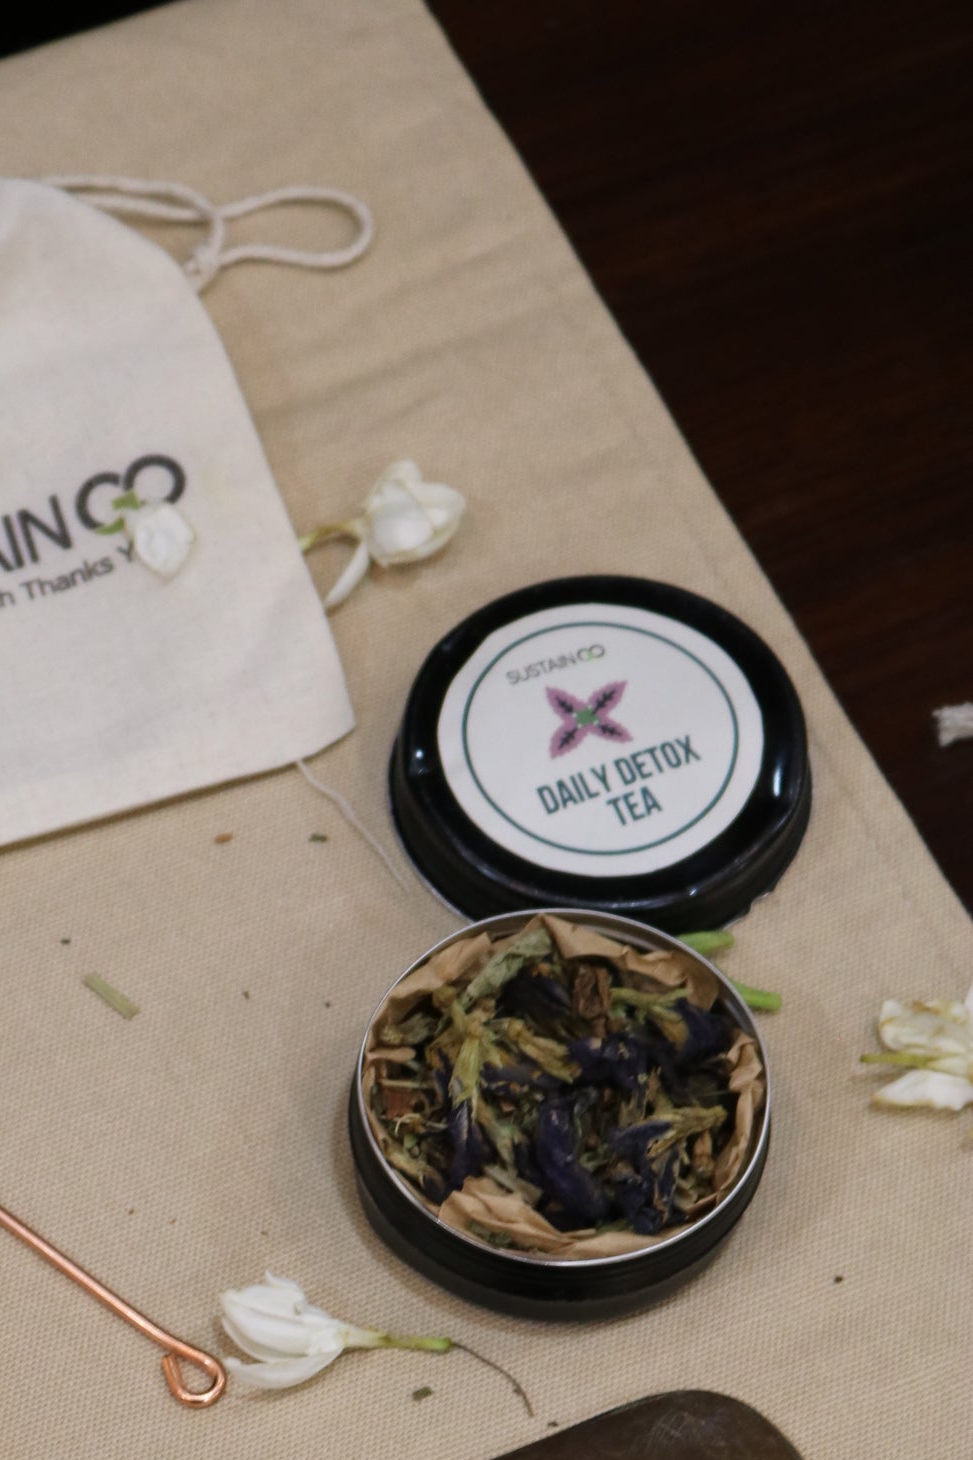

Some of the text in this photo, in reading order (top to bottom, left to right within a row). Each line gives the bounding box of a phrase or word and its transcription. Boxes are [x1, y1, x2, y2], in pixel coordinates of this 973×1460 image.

[20, 556, 115, 600] Thanks
[536, 734, 702, 814] DAILY DETOX
[606, 786, 663, 826] TEA
